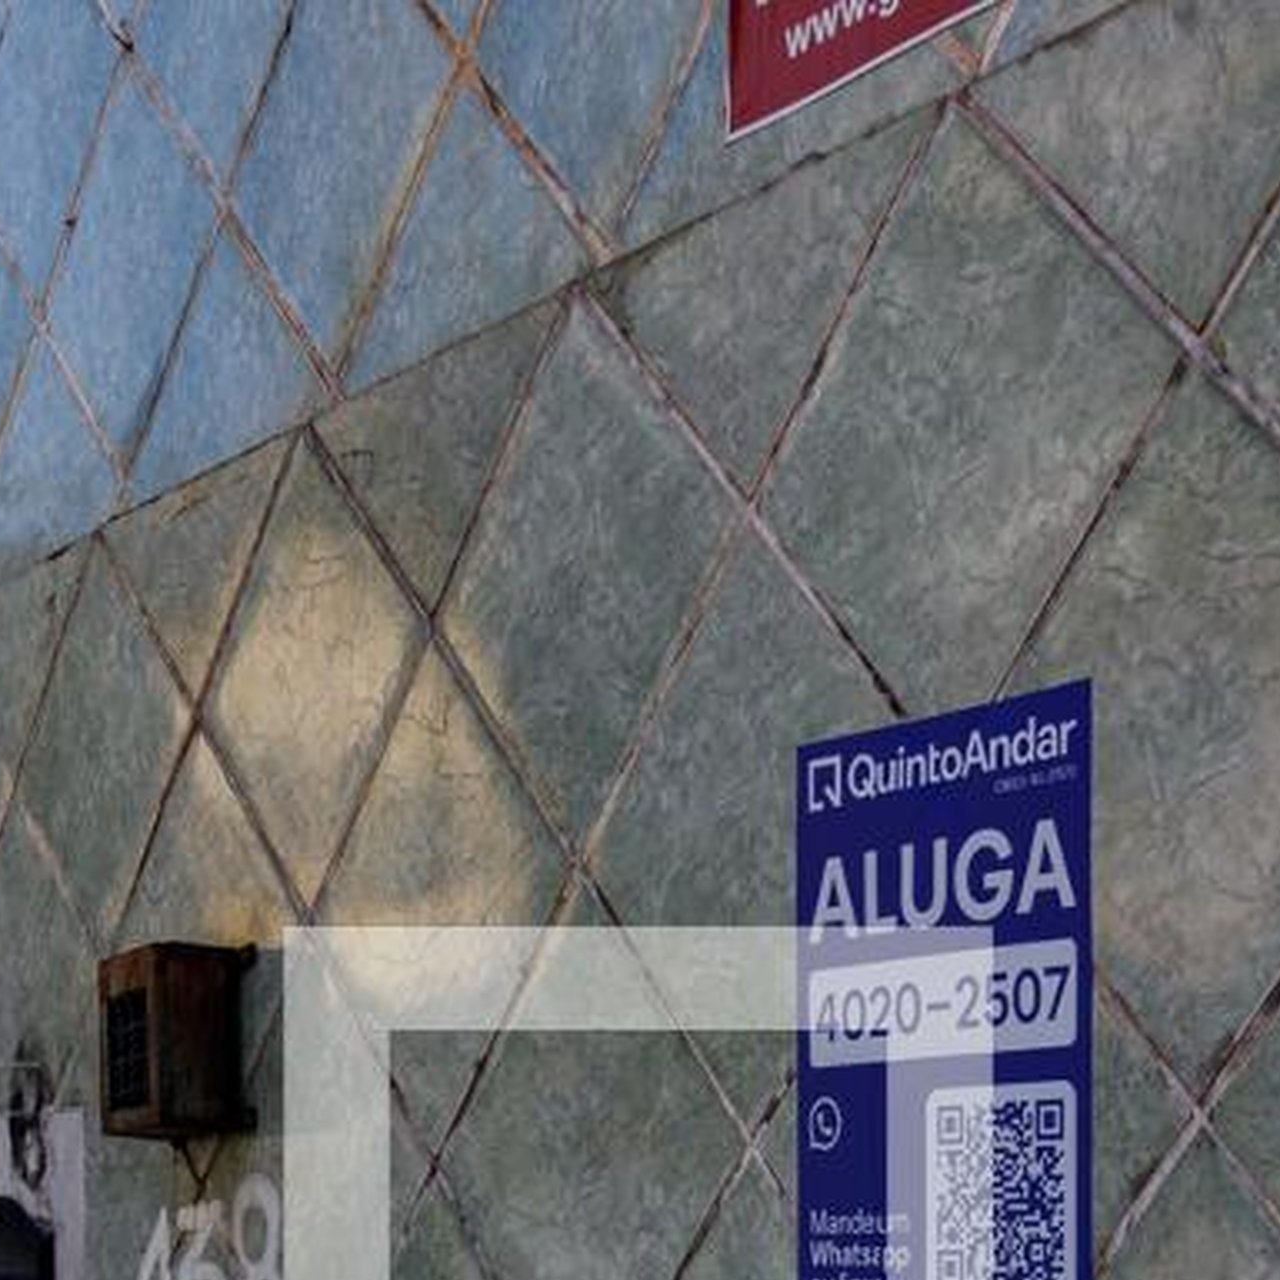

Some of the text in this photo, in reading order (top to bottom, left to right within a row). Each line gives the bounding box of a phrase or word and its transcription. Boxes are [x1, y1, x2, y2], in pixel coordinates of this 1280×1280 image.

[847, 716, 1078, 799] QuintoAndar
[808, 817, 1076, 943] ALUGA
[816, 964, 1071, 1043] 4020-2507
[809, 1207, 875, 1236] Mande
